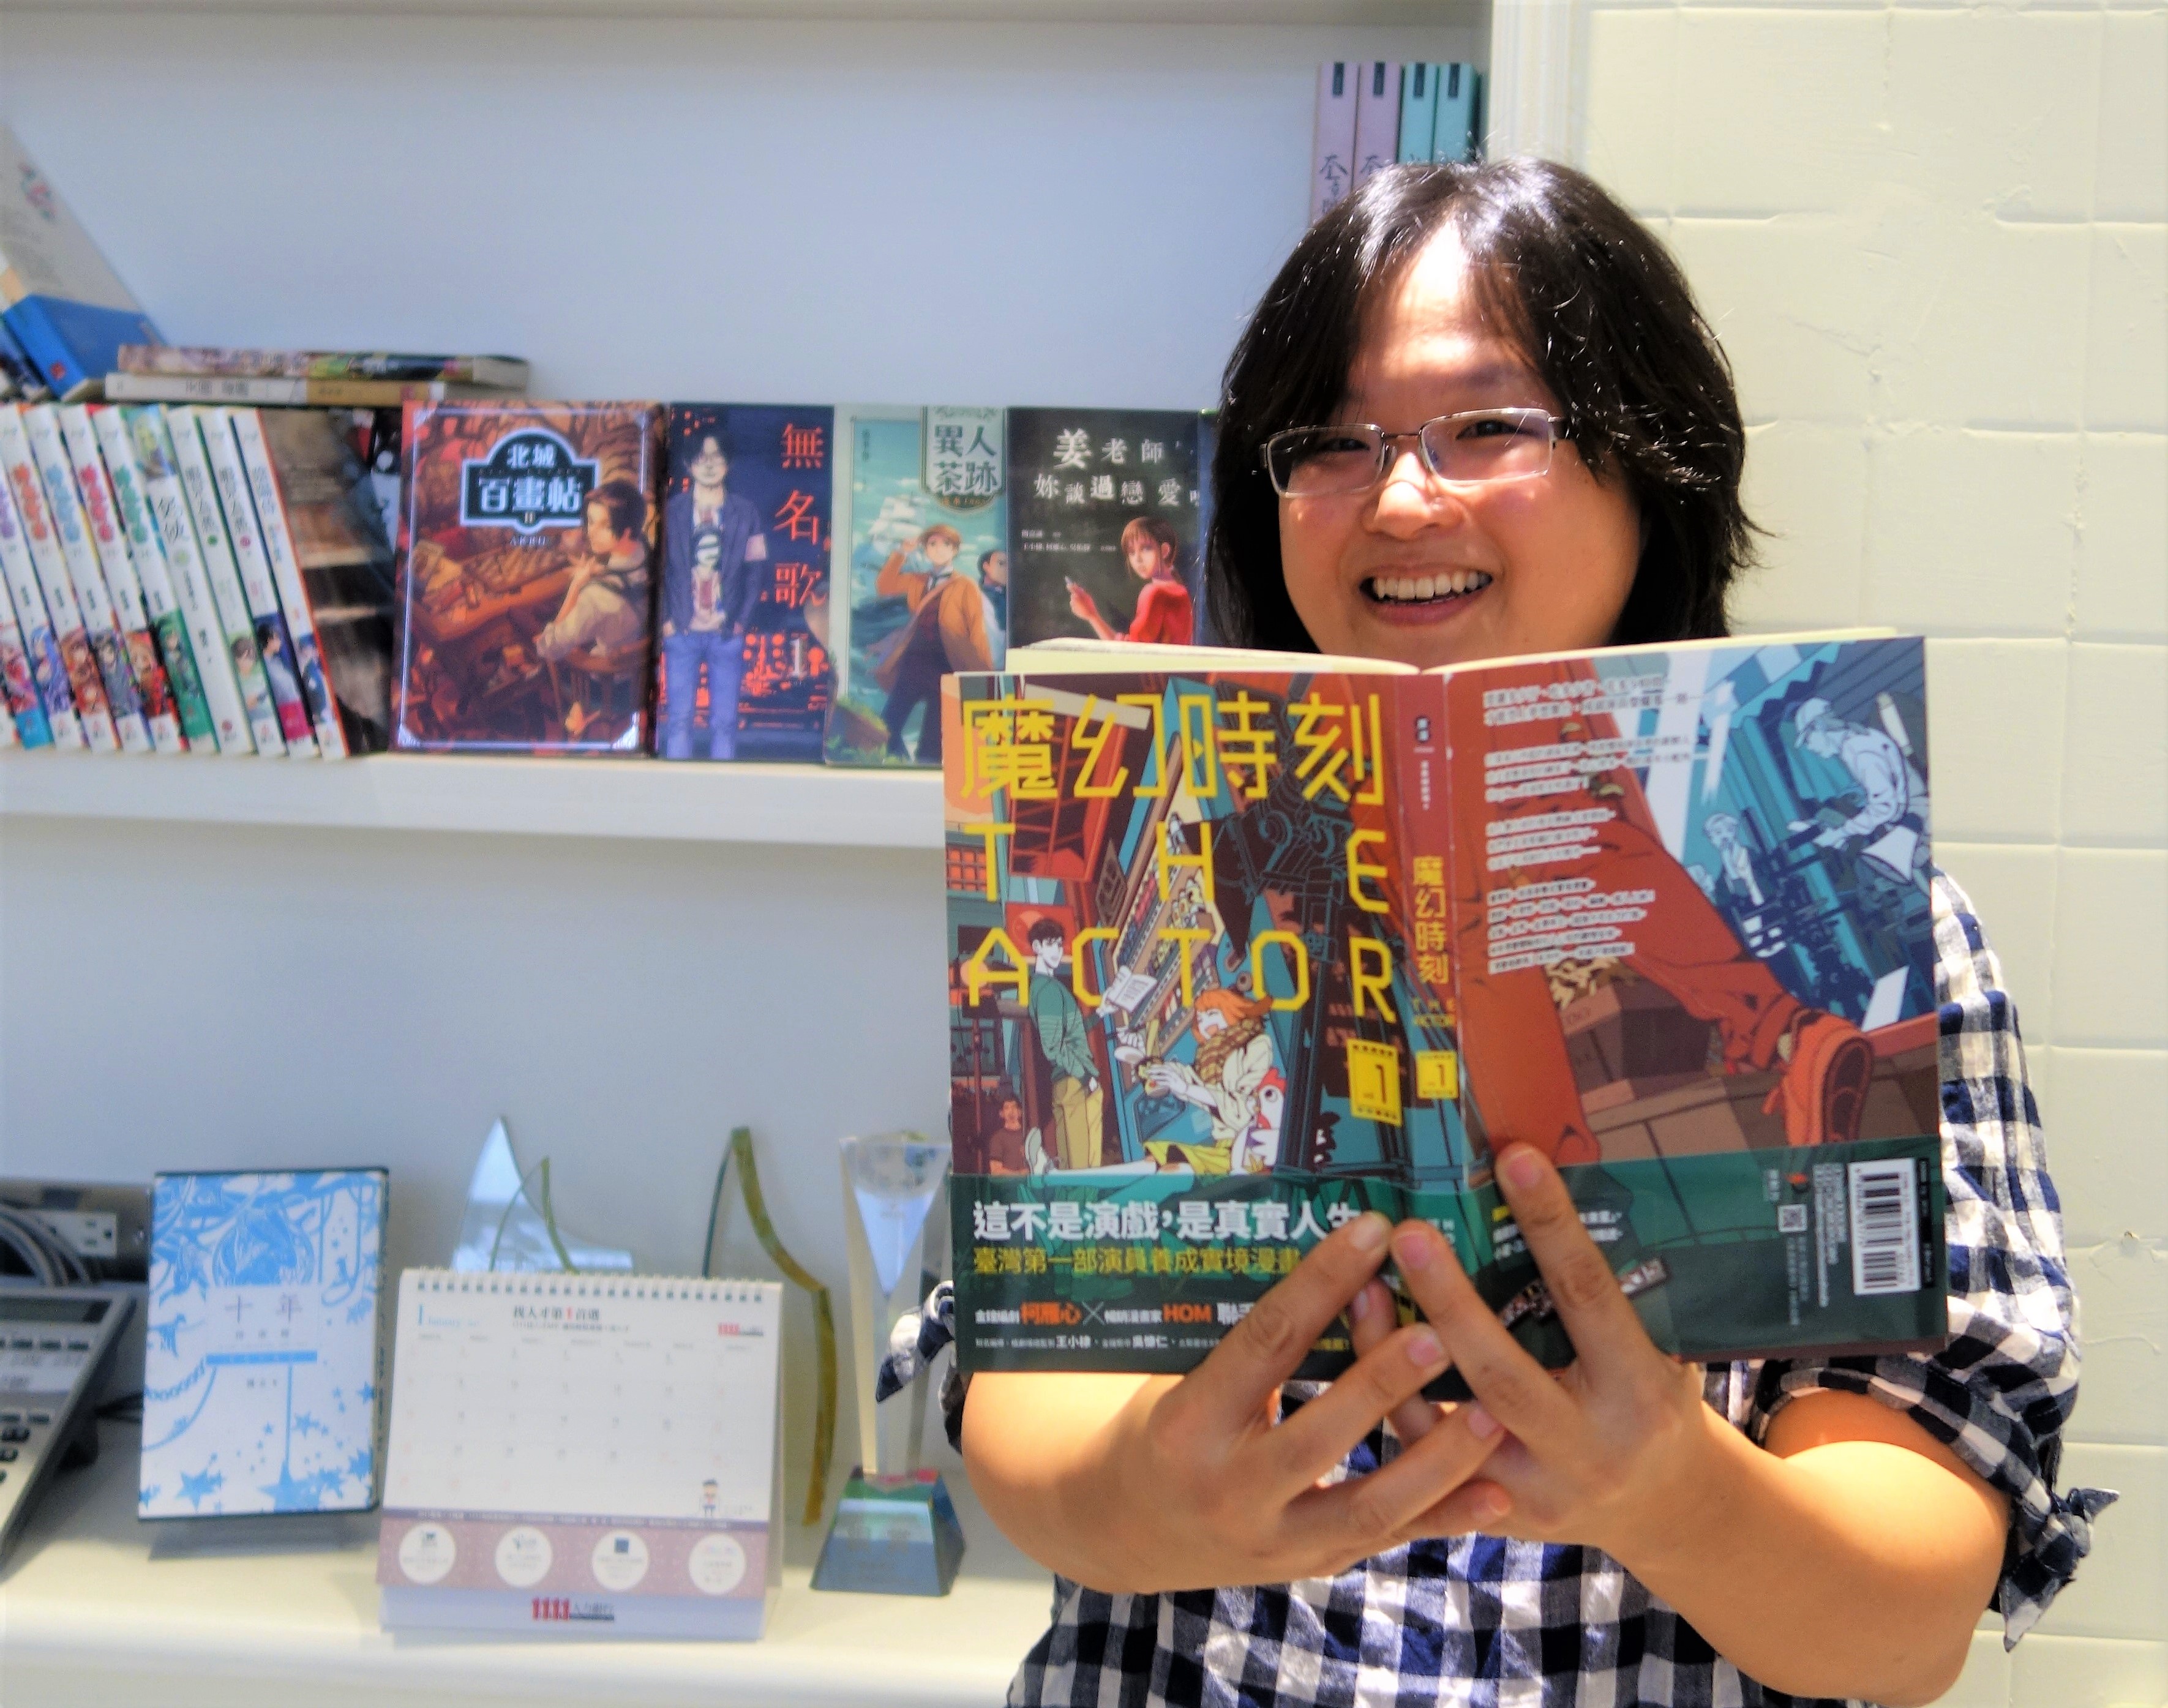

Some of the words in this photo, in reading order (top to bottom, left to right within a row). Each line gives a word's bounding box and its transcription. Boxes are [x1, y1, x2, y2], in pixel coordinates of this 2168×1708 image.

[933, 424, 996, 457] 異人
[478, 476, 582, 513] 百畫帖
[933, 460, 997, 492] 茶跡
[773, 422, 827, 609] 無名歌
[961, 691, 1385, 805] 魔幻時刻
[964, 823, 1390, 913] THE
[1412, 856, 1449, 985] 魔幻時刻
[968, 927, 1397, 1024] ACTOR
[1375, 1063, 1387, 1104] 1
[1164, 1303, 1212, 1324] HOM
